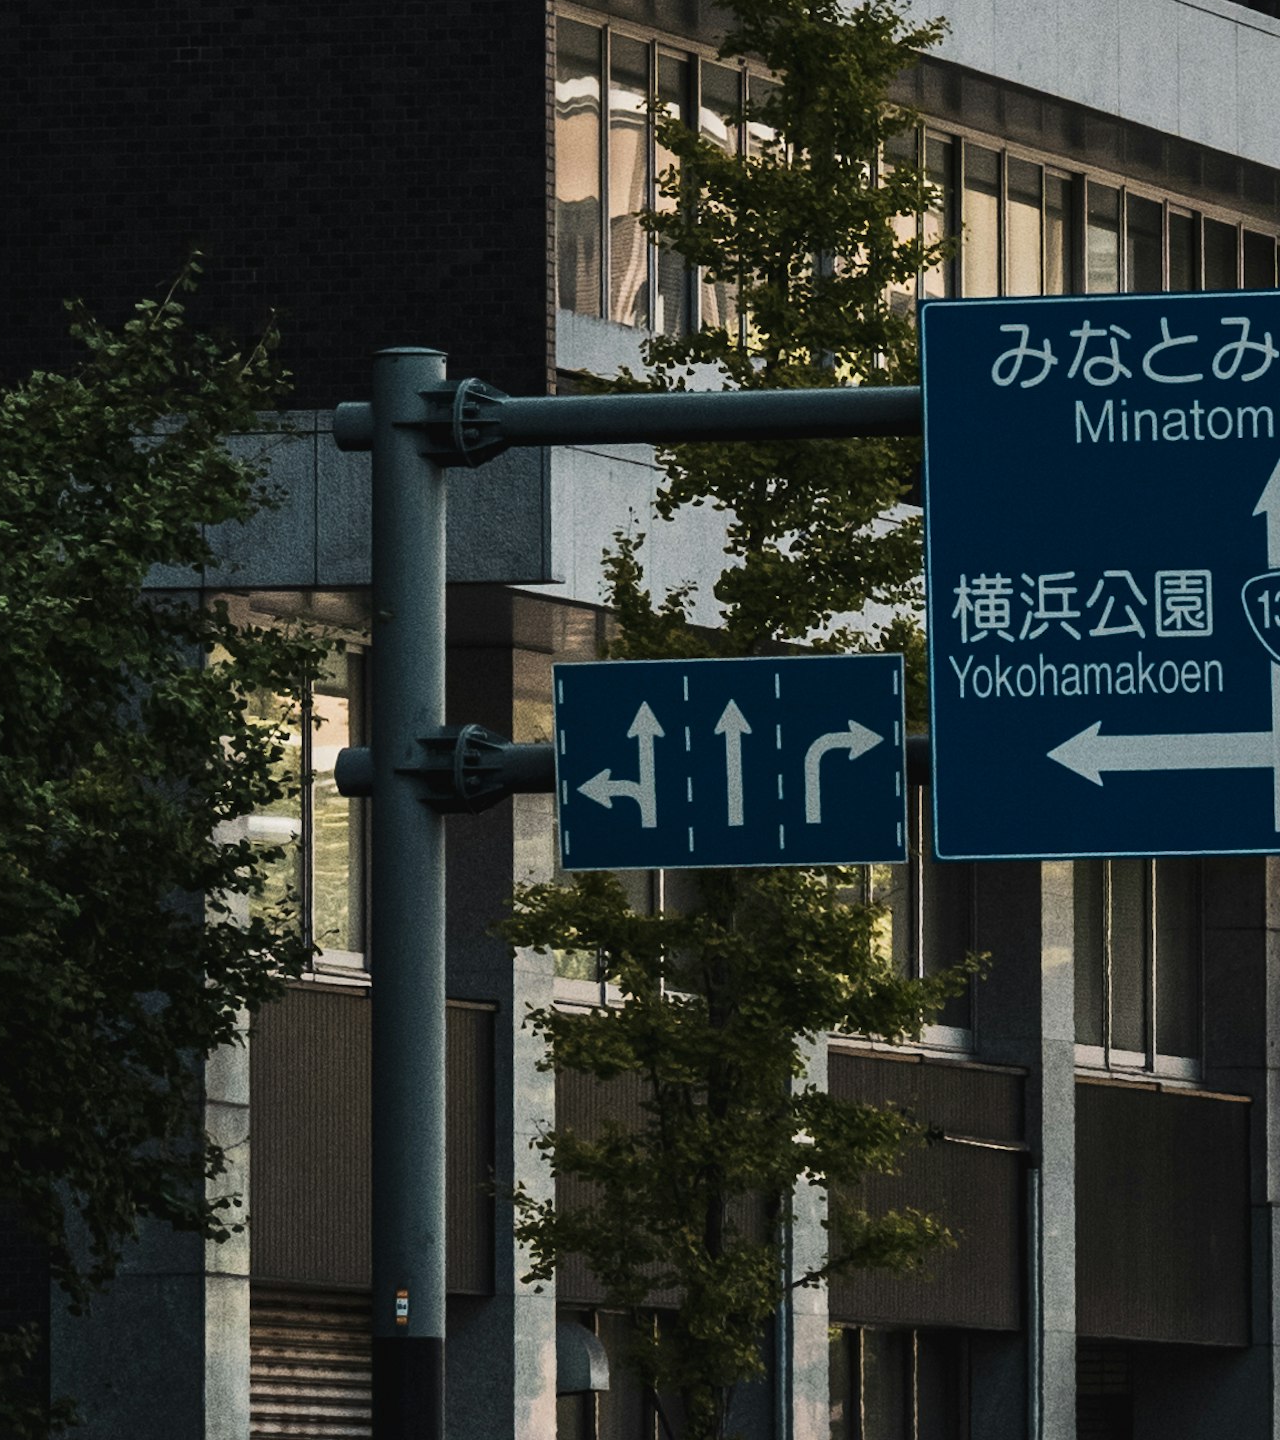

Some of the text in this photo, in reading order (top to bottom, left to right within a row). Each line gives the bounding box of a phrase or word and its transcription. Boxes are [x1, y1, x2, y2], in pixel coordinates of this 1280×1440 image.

[951, 569, 1214, 644] 横浜公園
[948, 650, 1224, 699] Yokohamakoen
